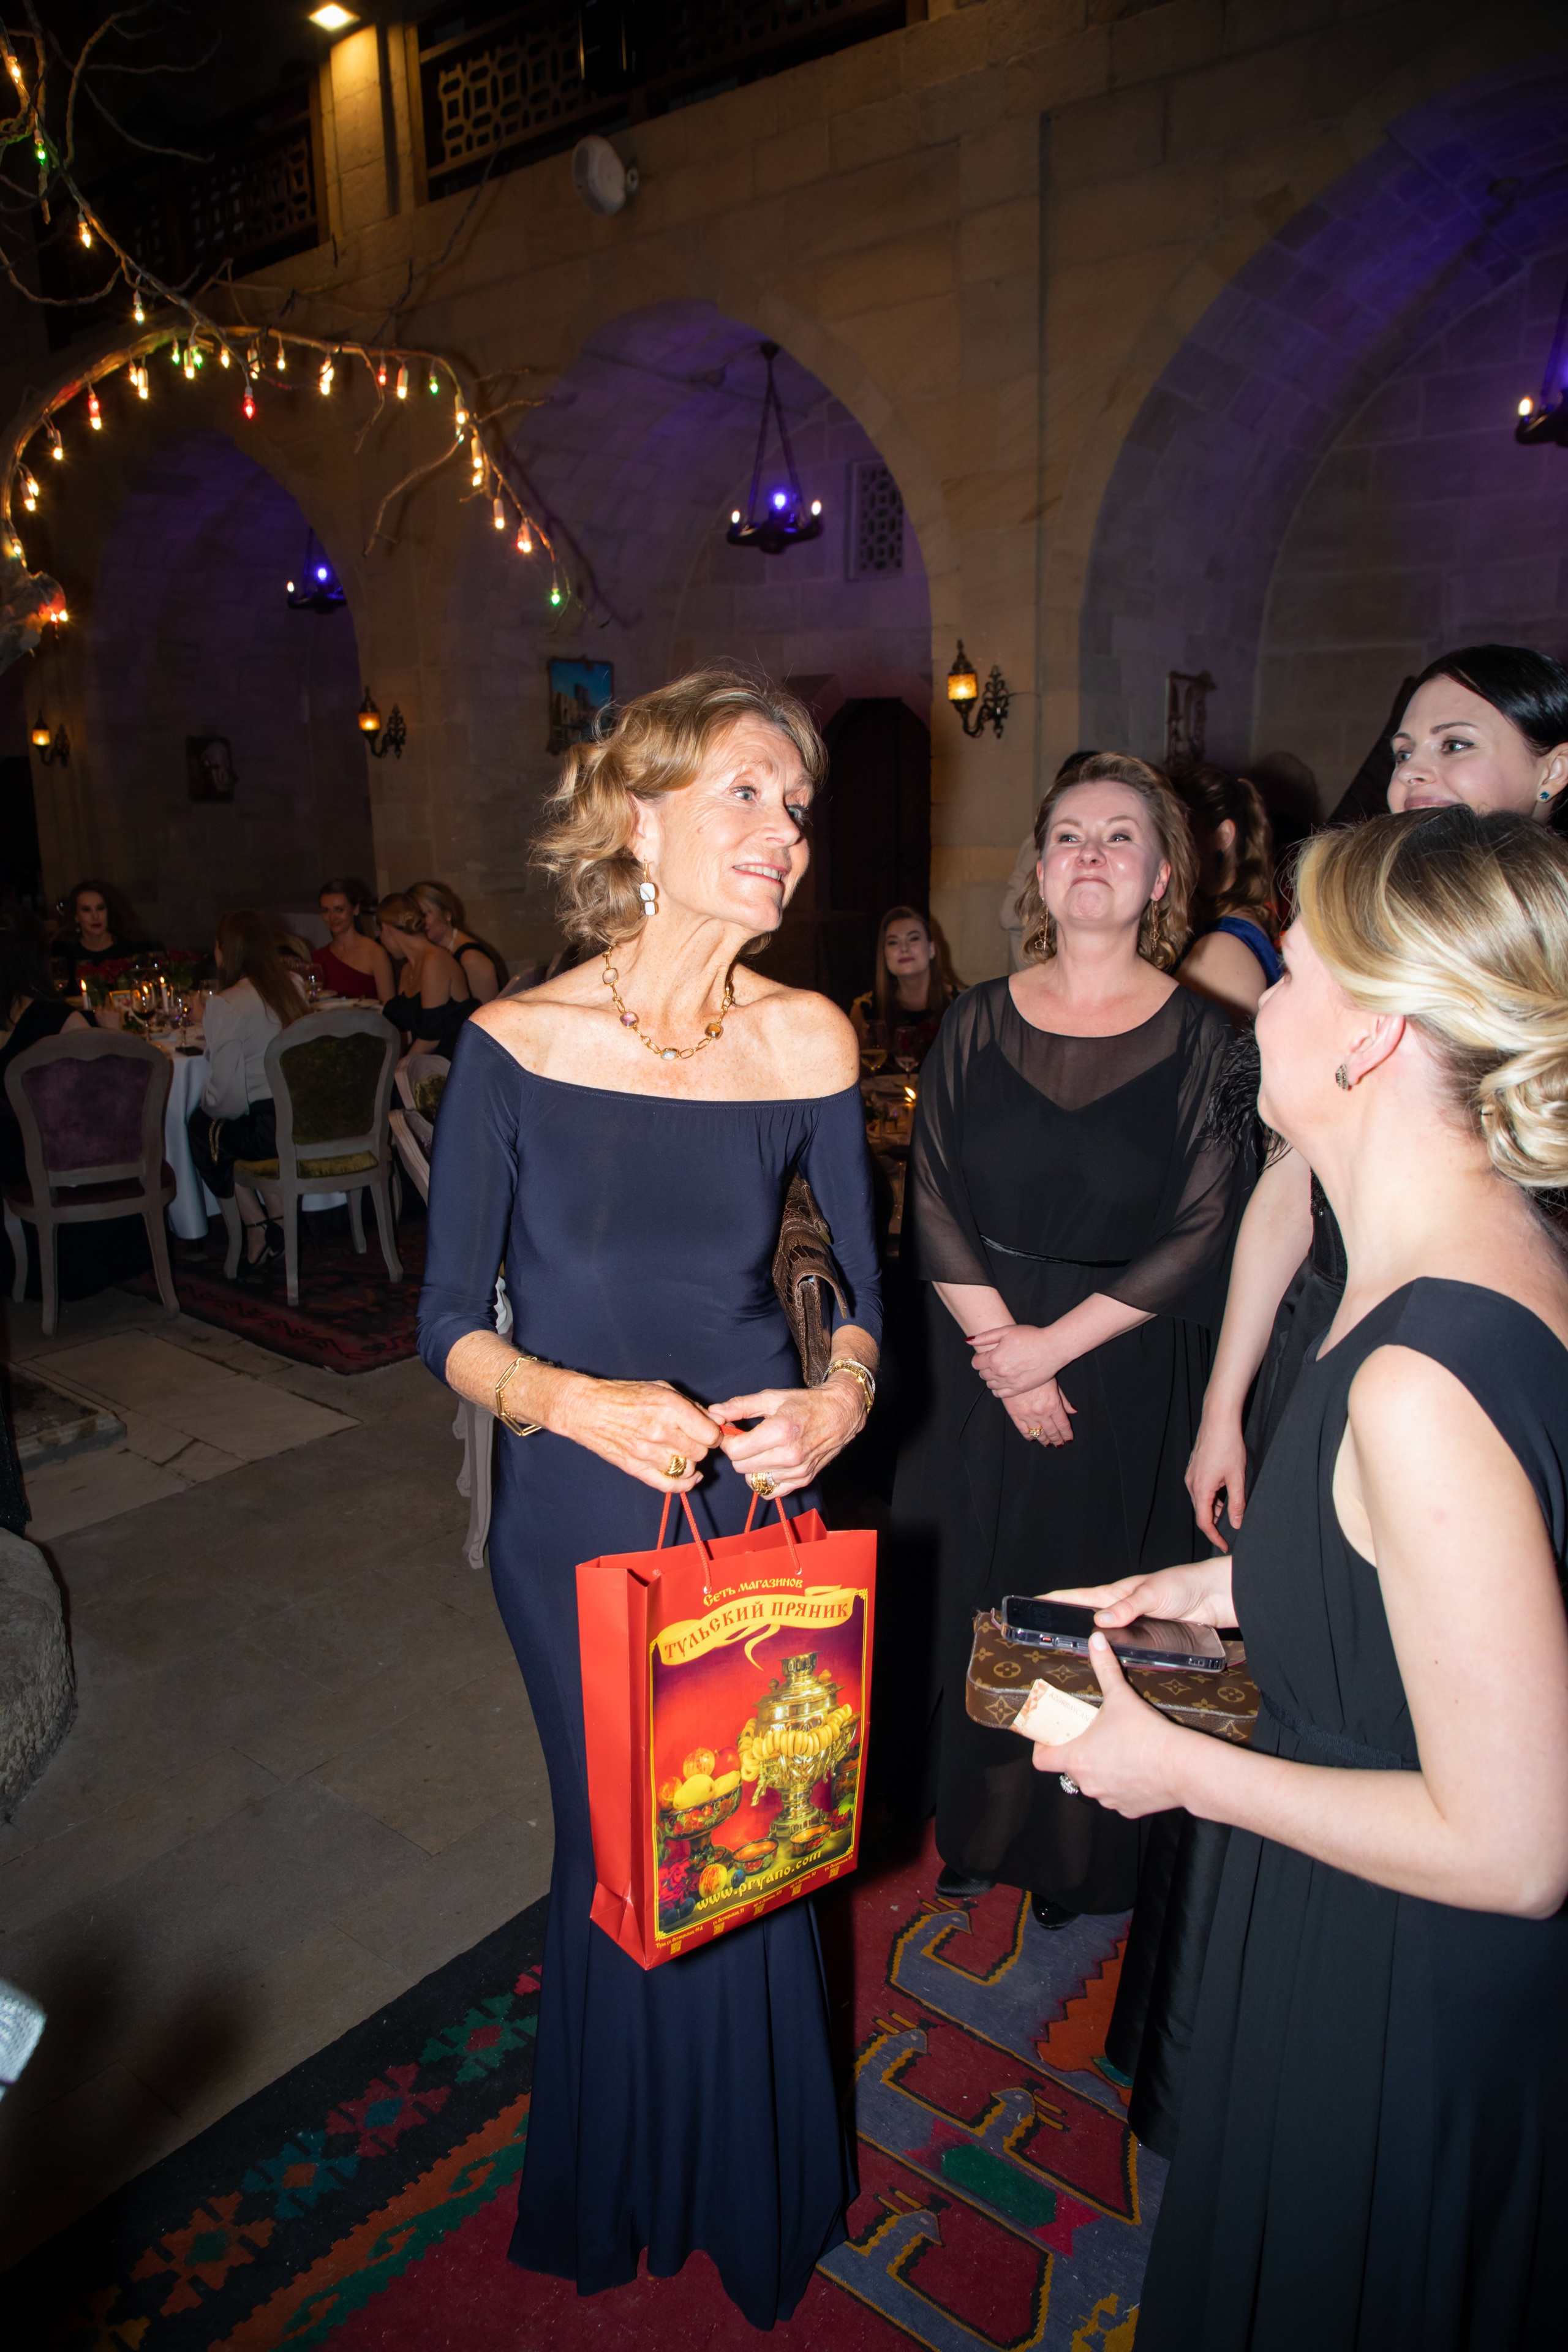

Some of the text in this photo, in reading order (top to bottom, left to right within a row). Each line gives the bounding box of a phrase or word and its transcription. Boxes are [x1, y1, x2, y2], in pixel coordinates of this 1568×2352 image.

[665, 1601, 848, 1659] ТУЛЬСКИЙ ПРЯНИК
[1049, 1692, 1090, 1722] AZƏRBAYCAN
[696, 1850, 822, 1911] www.pryano.com
